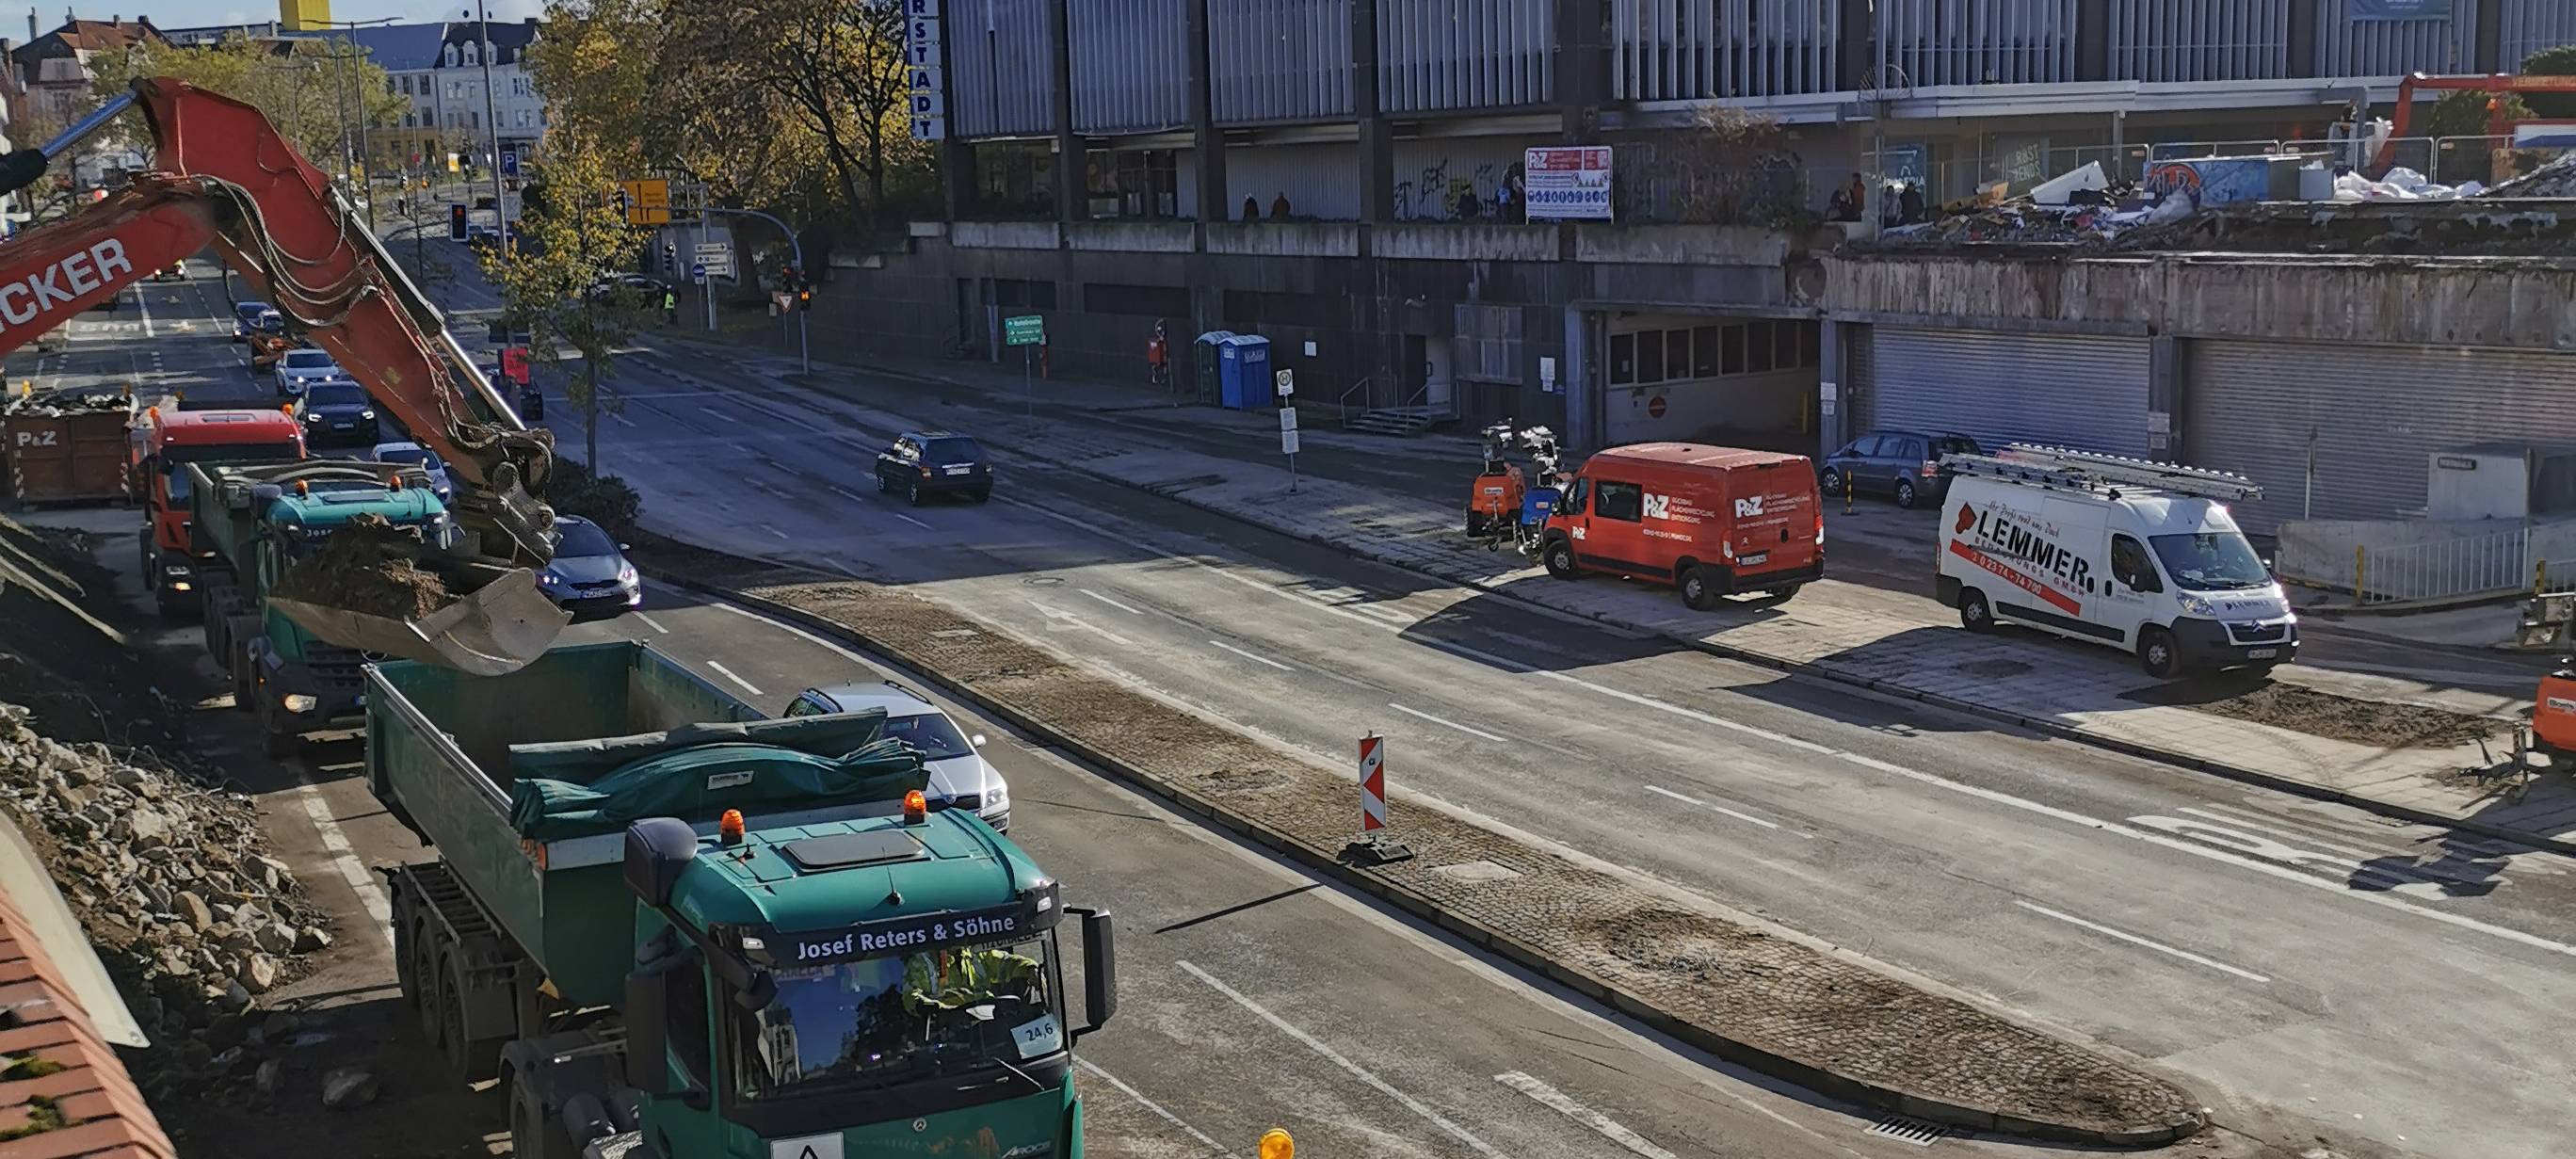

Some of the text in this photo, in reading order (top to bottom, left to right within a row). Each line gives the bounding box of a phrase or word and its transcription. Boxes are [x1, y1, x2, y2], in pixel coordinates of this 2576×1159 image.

[0, 238, 132, 332] CKER
[1643, 493, 1669, 520] P&Z
[1734, 495, 1763, 518] P&Z
[797, 915, 1015, 960] Josef Reters & Söhne
[1025, 1022, 1054, 1042] 24,6
